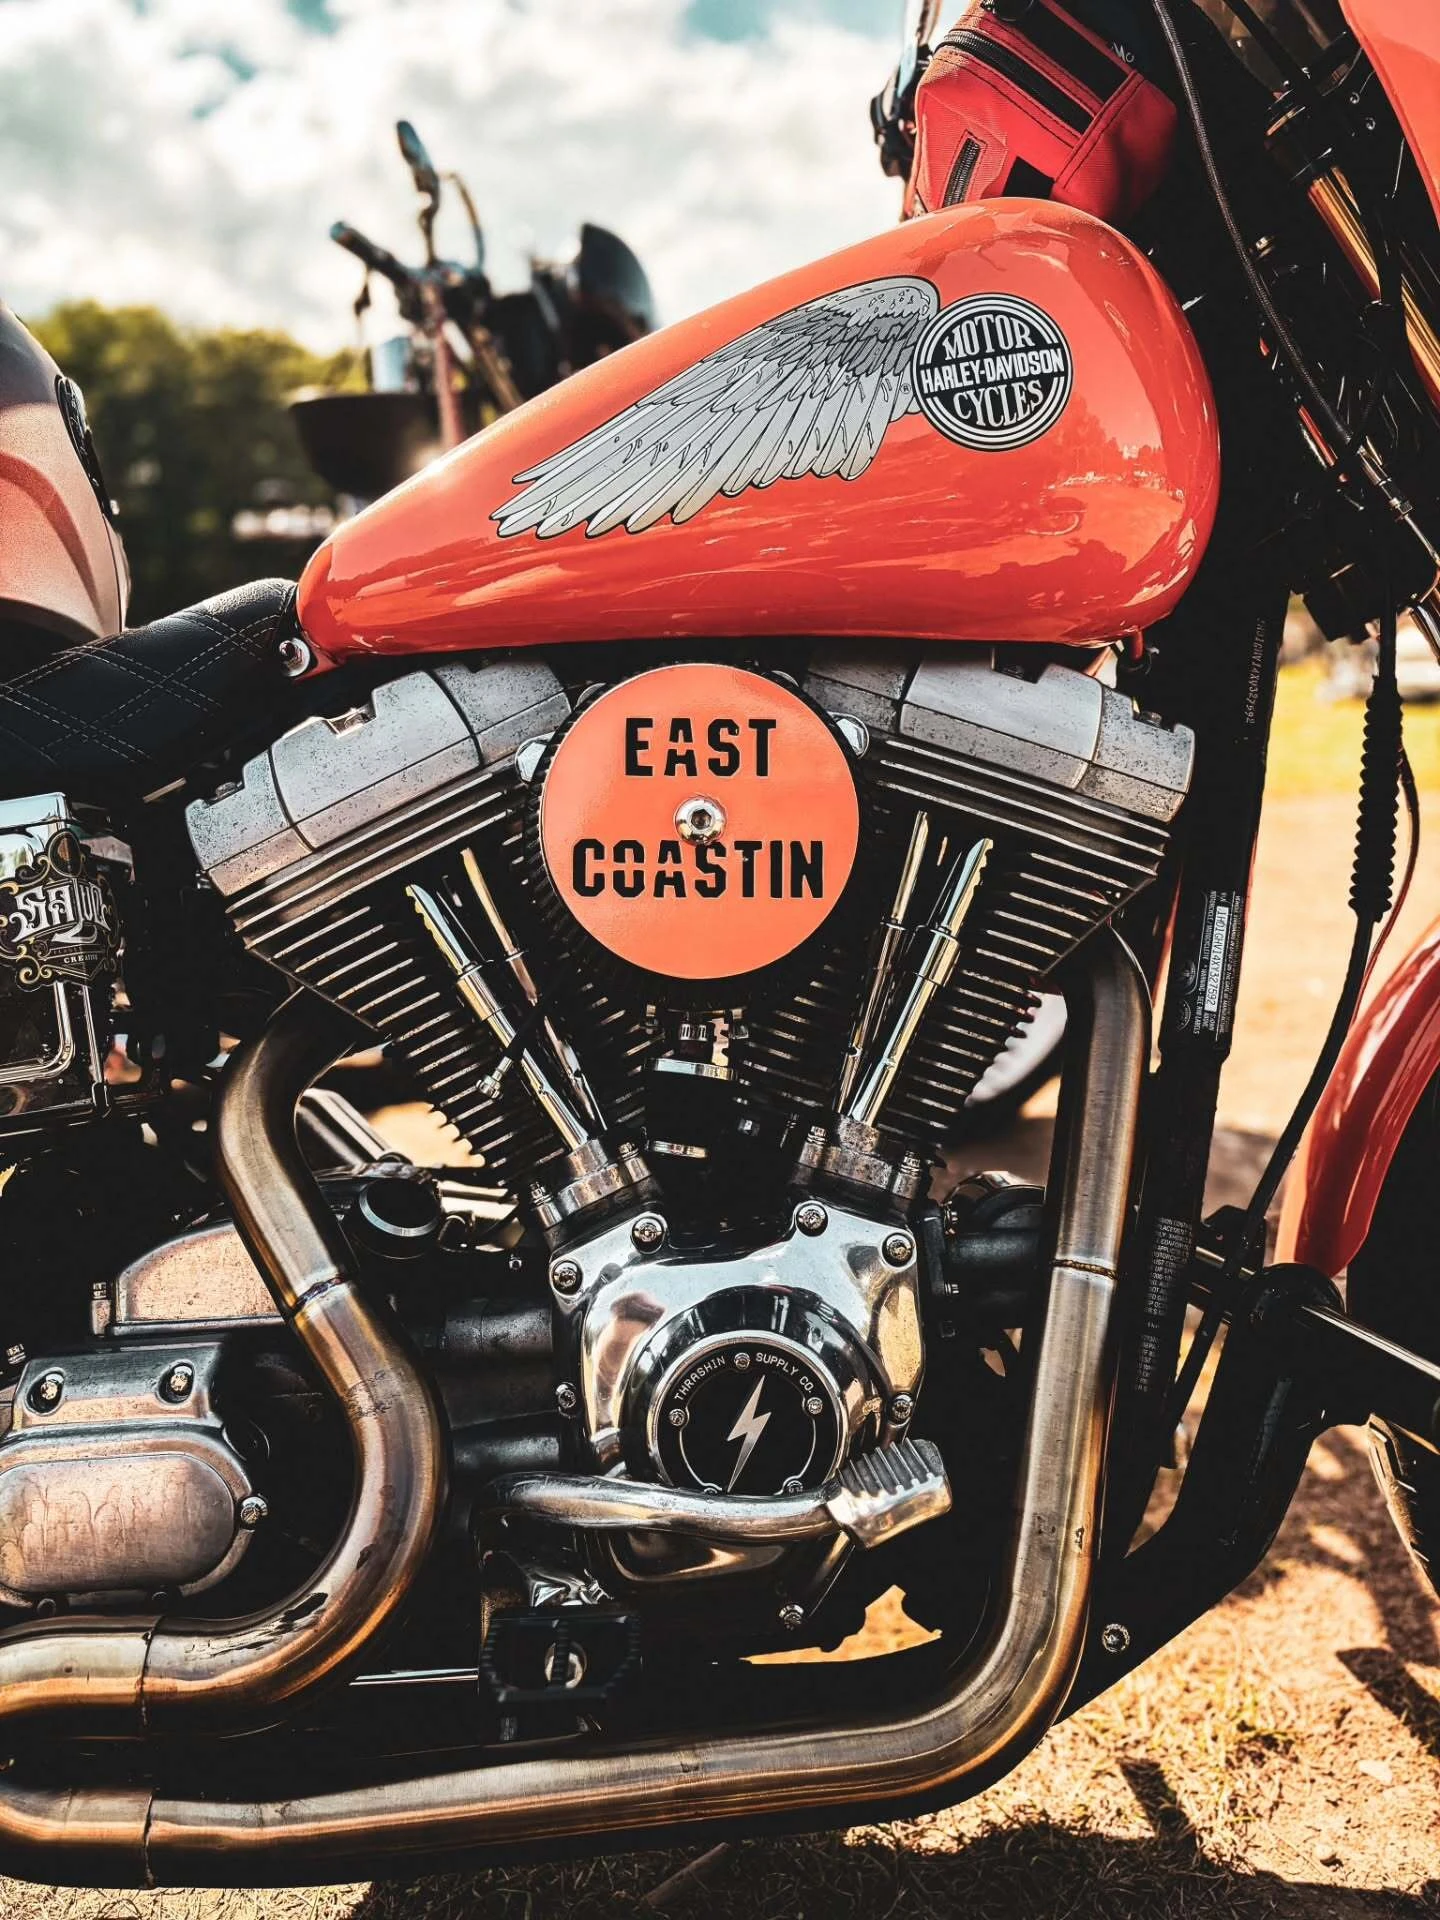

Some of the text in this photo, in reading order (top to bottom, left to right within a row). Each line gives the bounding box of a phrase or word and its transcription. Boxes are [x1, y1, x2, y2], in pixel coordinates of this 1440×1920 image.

[942, 314, 1036, 362] MOTOR
[920, 348, 1065, 394] HARLEY-DAVIDSON
[953, 379, 1044, 428] CYCLES
[625, 717, 777, 777] EAST
[572, 838, 824, 898] COASTIN
[674, 1352, 813, 1401] THRASHIN SUPPLY CO.
